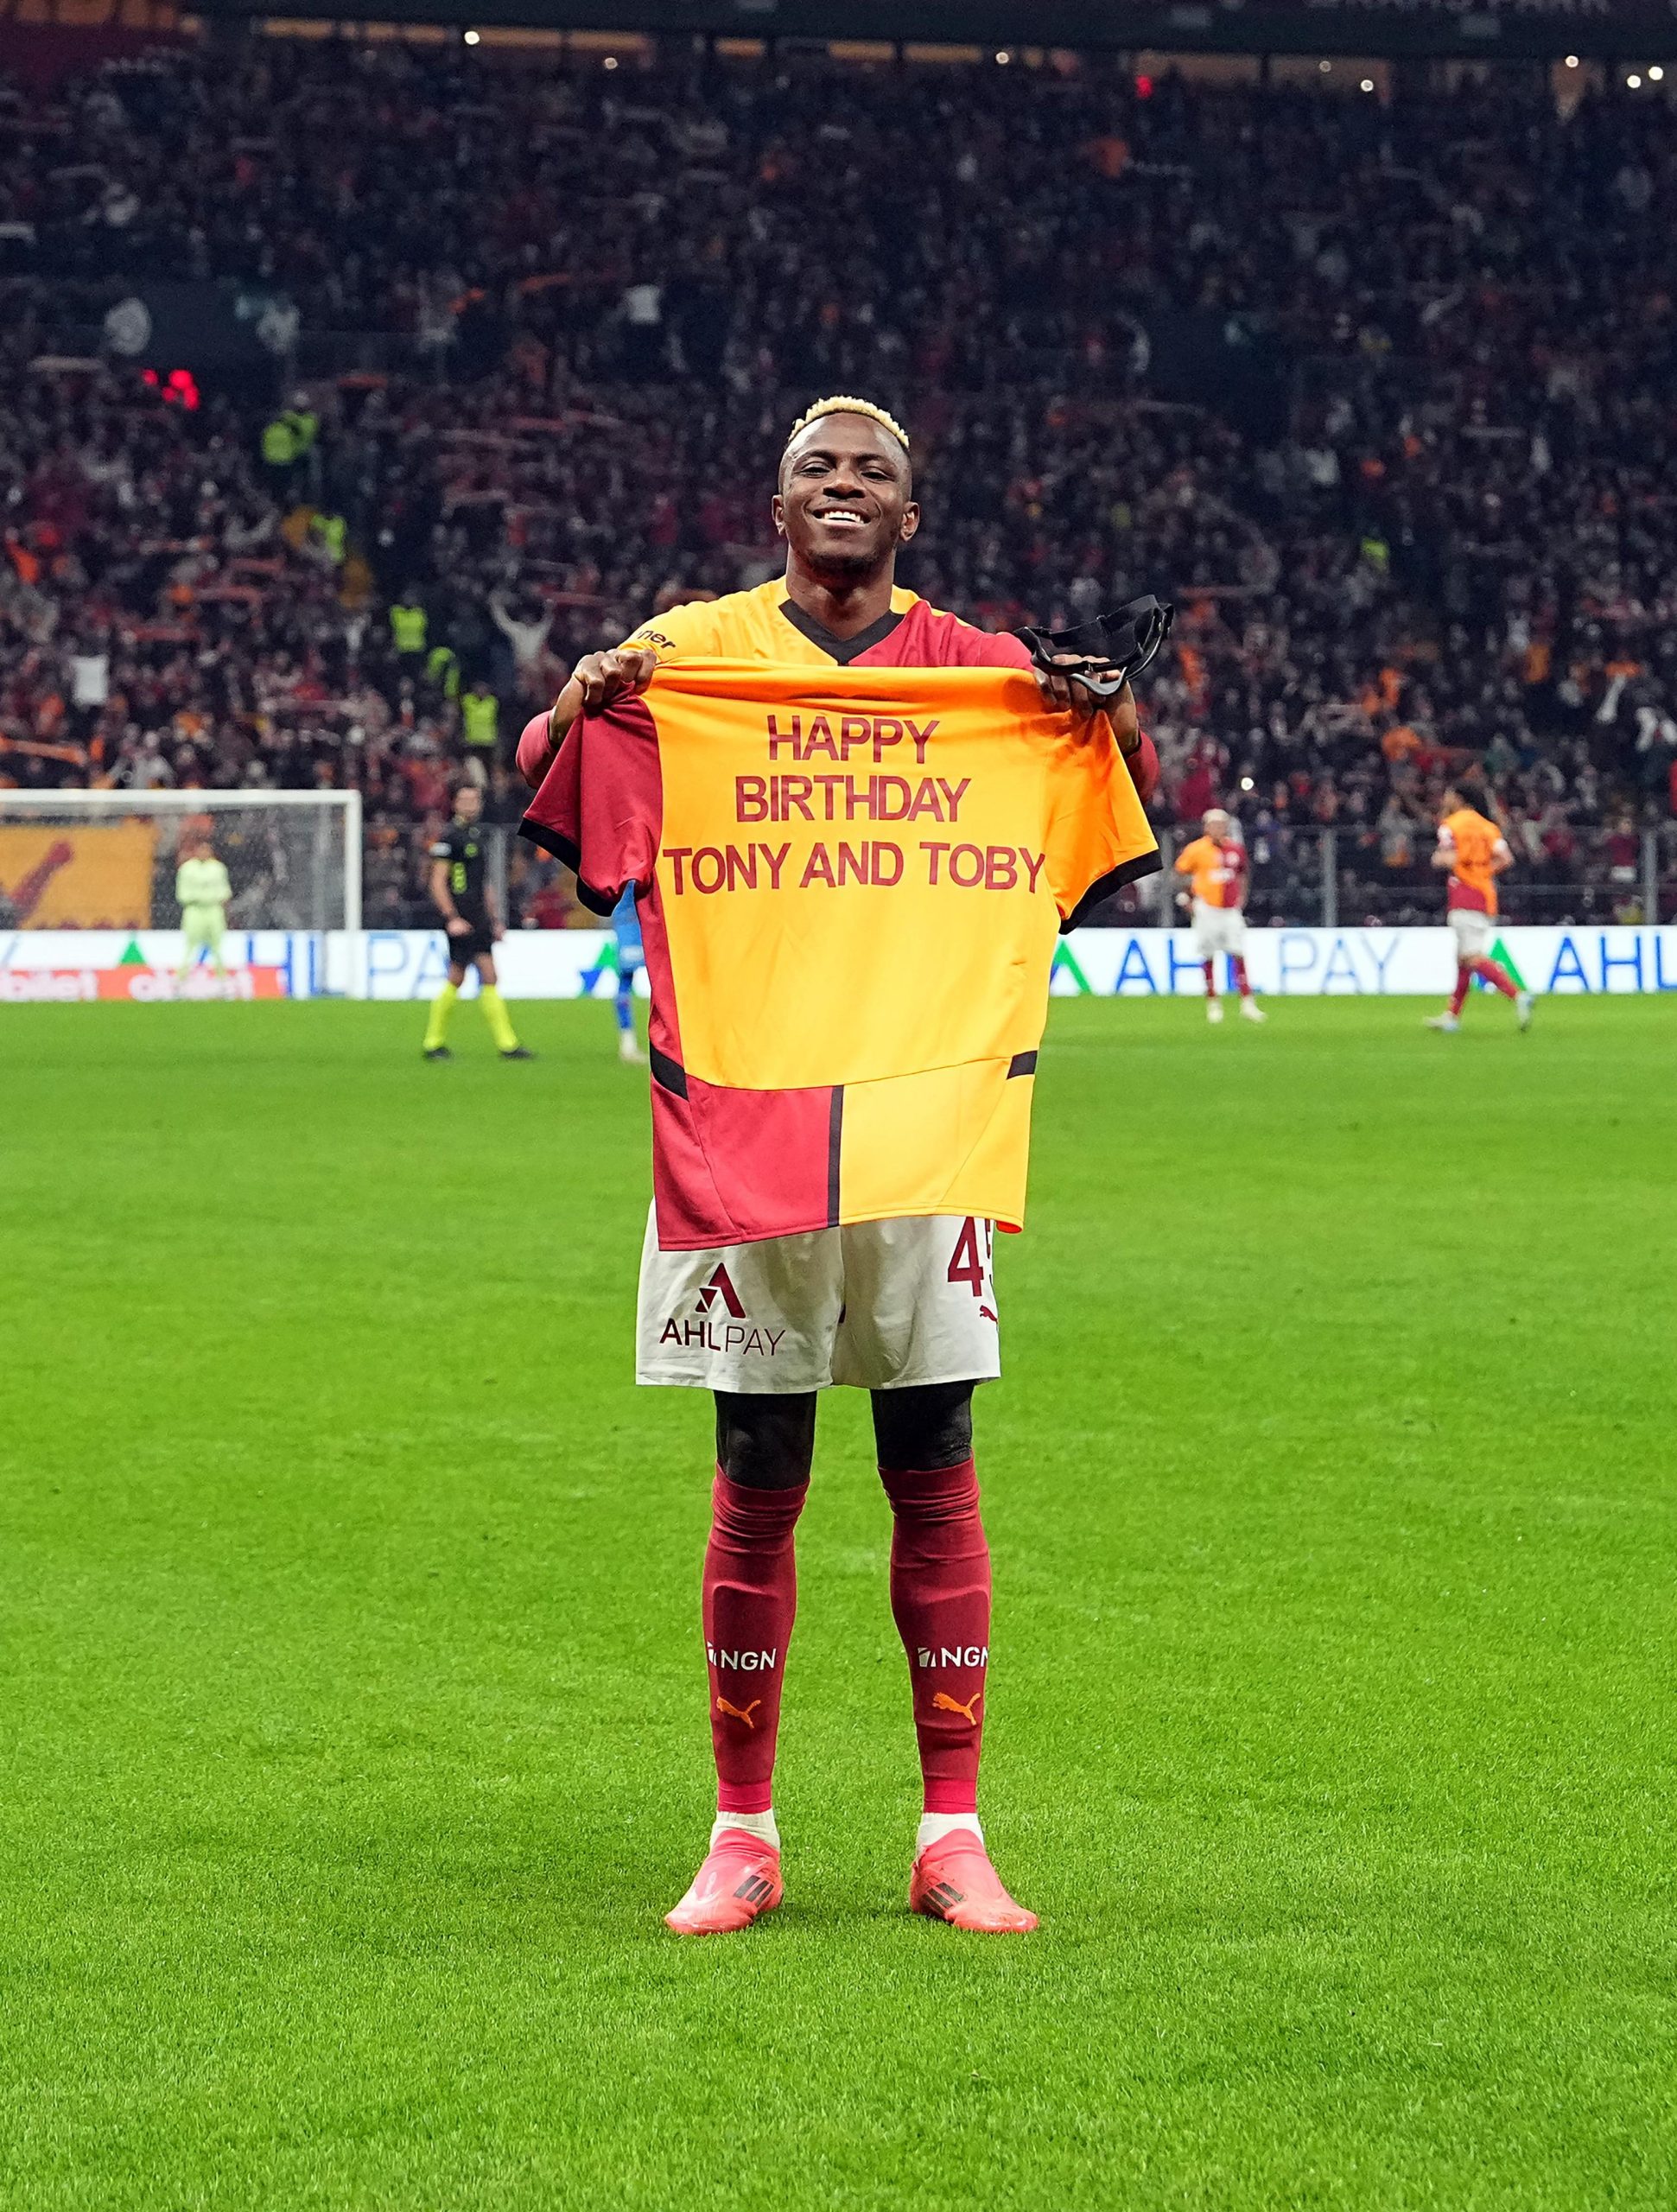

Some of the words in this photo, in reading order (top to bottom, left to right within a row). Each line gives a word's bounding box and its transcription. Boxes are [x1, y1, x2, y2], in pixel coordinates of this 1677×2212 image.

[637, 630, 677, 649] ner
[766, 715, 940, 764] HAPPY
[735, 775, 971, 823] BIRTHDAY
[663, 842, 791, 895] TONY
[799, 842, 905, 888] AND
[919, 842, 1045, 893] TOBY
[948, 1217, 991, 1296] 4
[659, 1318, 786, 1356] AHLPAY
